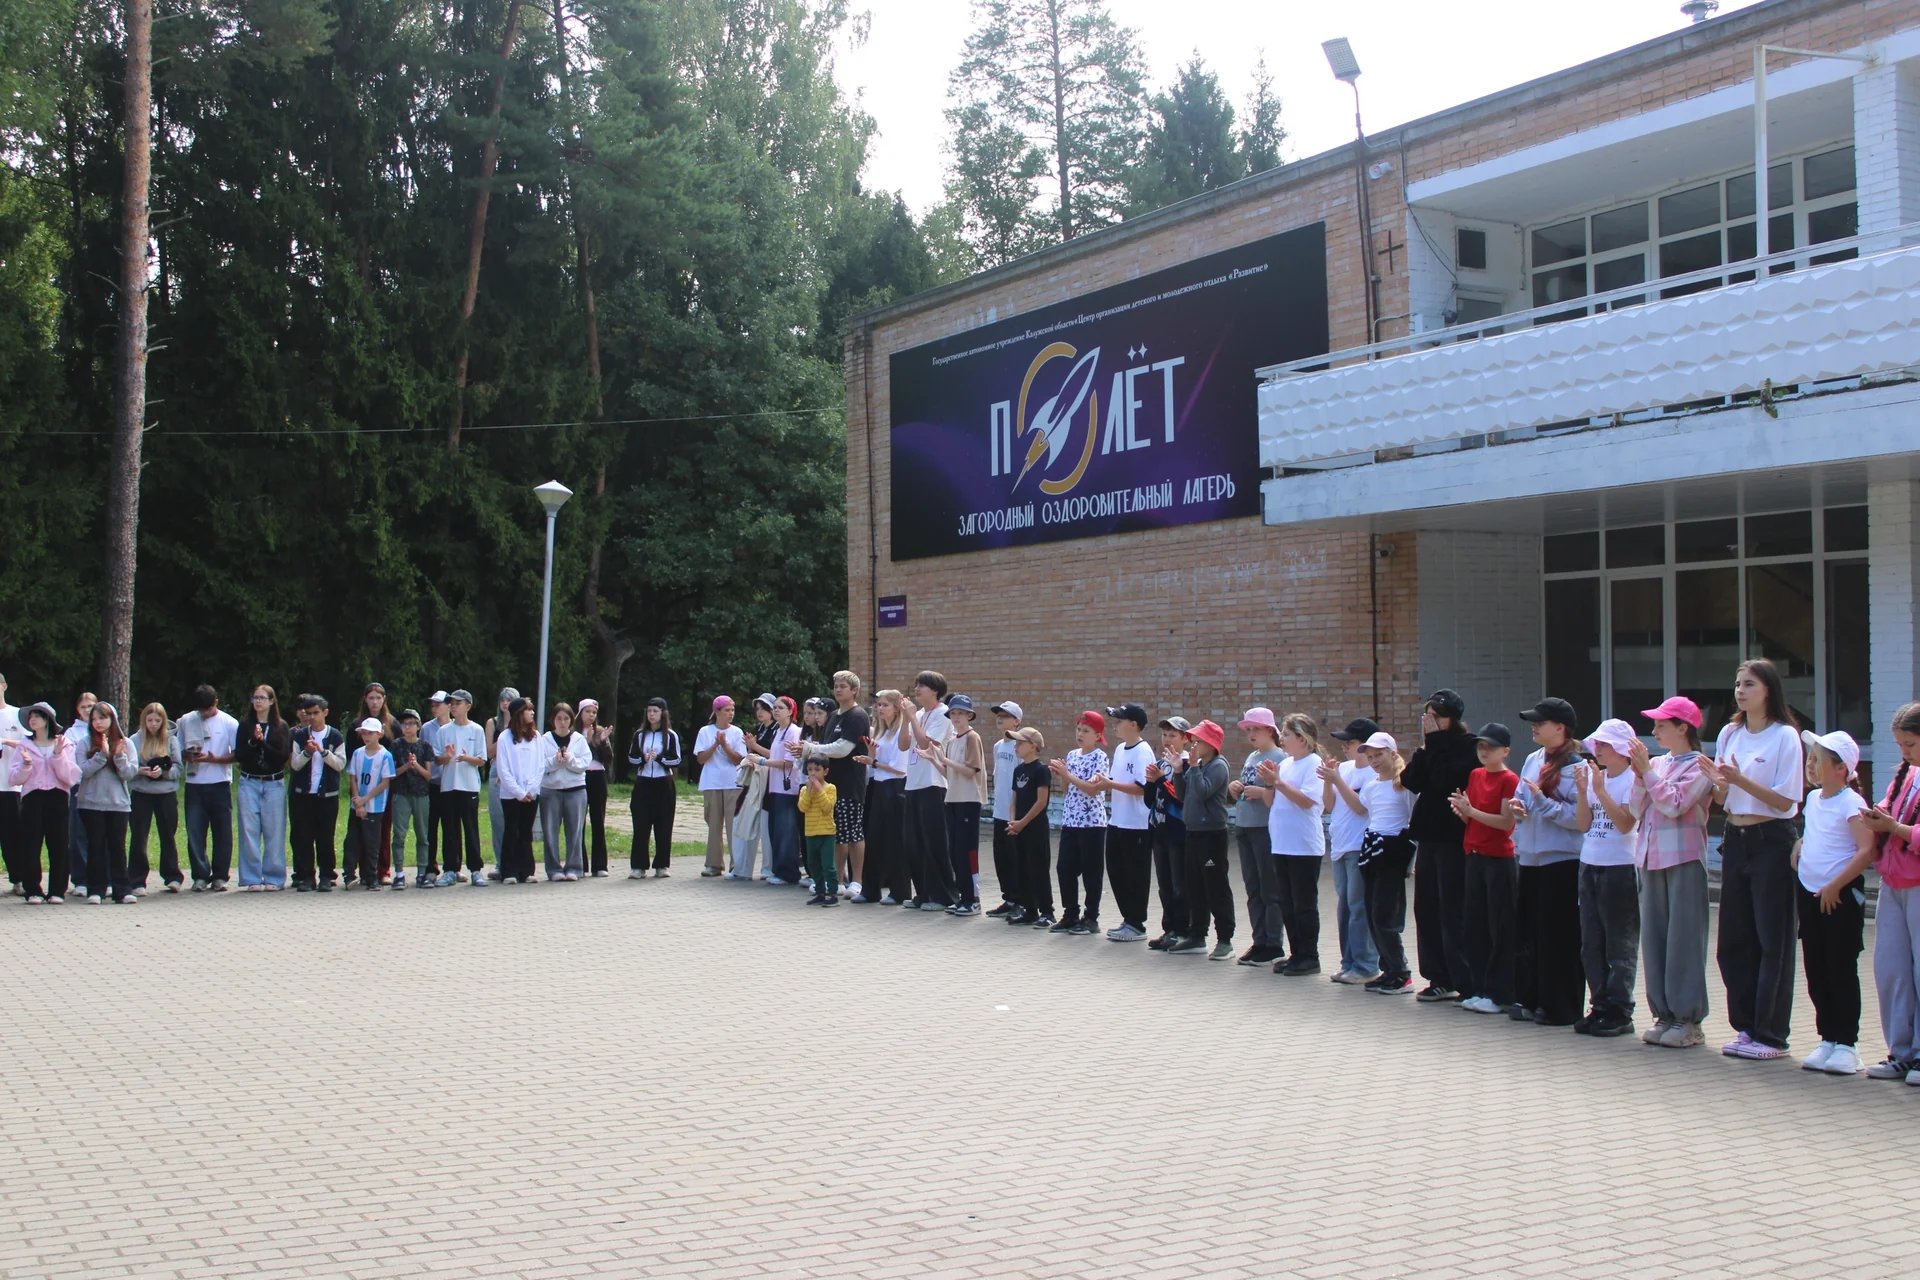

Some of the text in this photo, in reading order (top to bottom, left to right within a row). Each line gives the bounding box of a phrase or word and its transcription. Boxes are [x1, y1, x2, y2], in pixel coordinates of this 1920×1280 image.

[932, 351, 968, 366] Государственное
[1025, 325, 1053, 340] Калужской
[1096, 304, 1131, 320] организации
[1131, 294, 1157, 308] детского
[1203, 275, 1227, 288] отдыха
[1228, 263, 1269, 281] «Развитие»
[957, 473, 1236, 536] ЗАГОРОДНЫЙ ОЗДОРОВИТЕЛЬНЫЙ ЛАГЕРЬ
[360, 772, 371, 785] 10
[1603, 822, 1615, 830] ME
